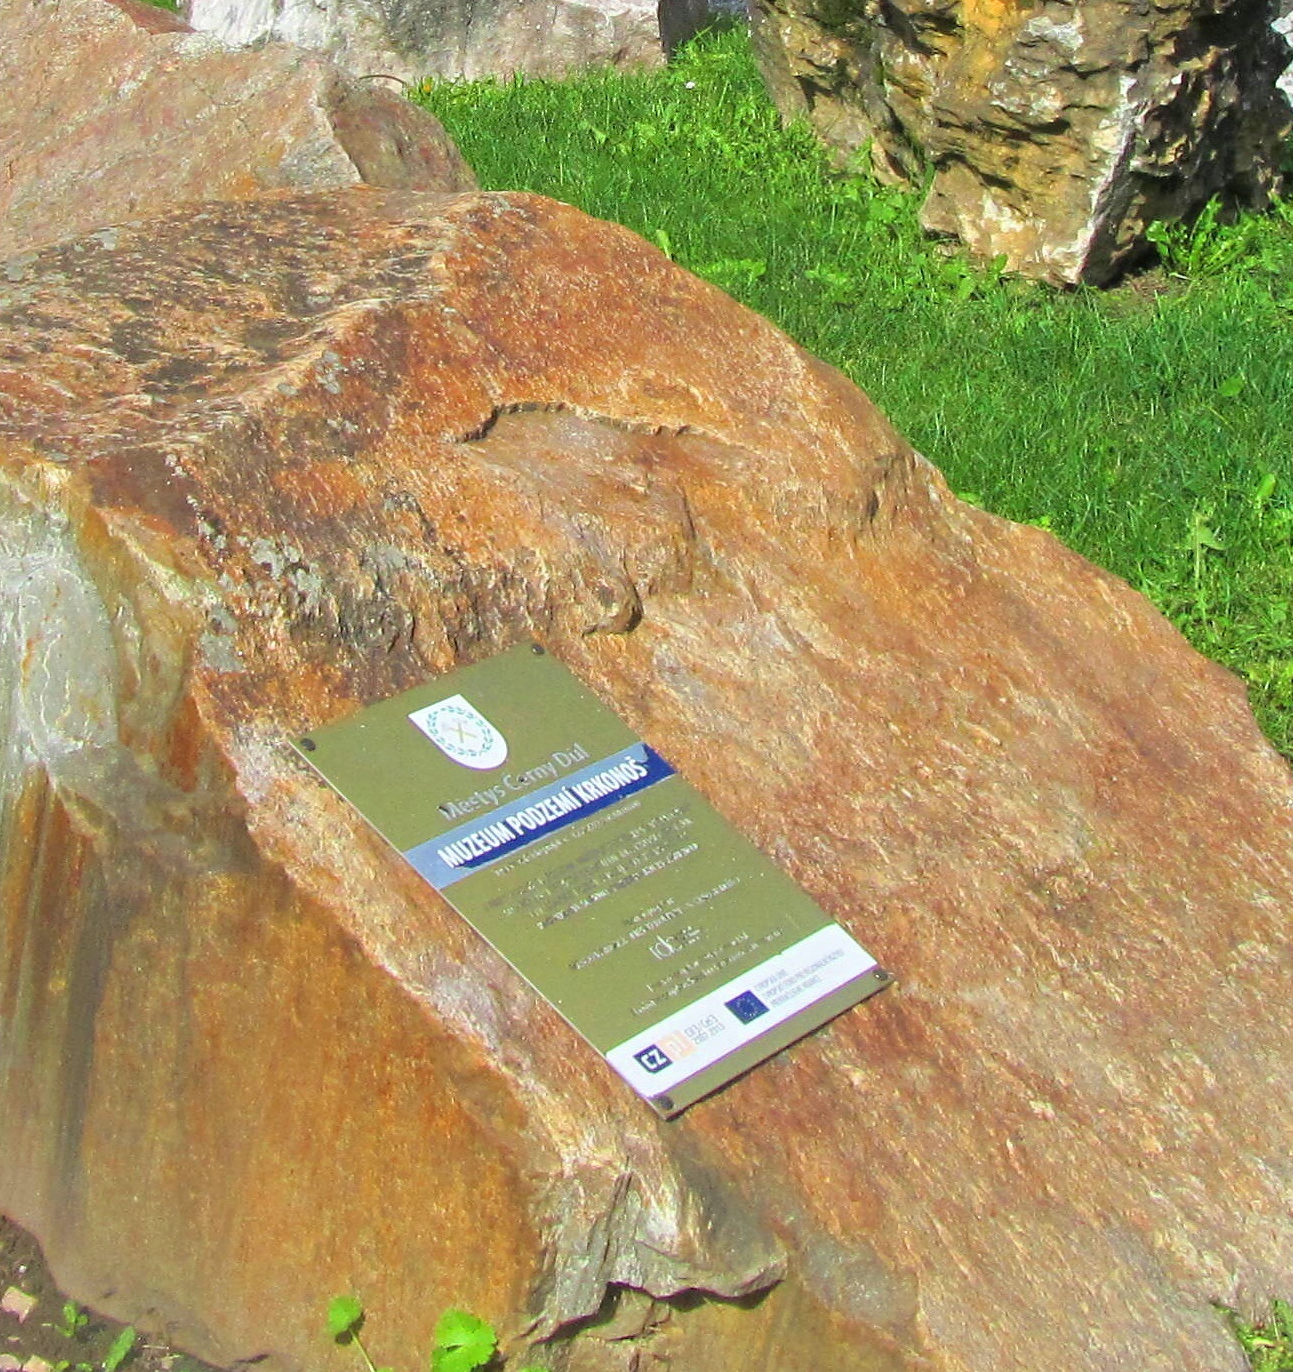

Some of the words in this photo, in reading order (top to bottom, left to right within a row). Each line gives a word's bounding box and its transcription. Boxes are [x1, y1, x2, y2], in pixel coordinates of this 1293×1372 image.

[437, 821, 516, 869] MUZEUM
[506, 787, 582, 835] PODZEMÍ
[571, 756, 648, 803] KRKONOŠ
